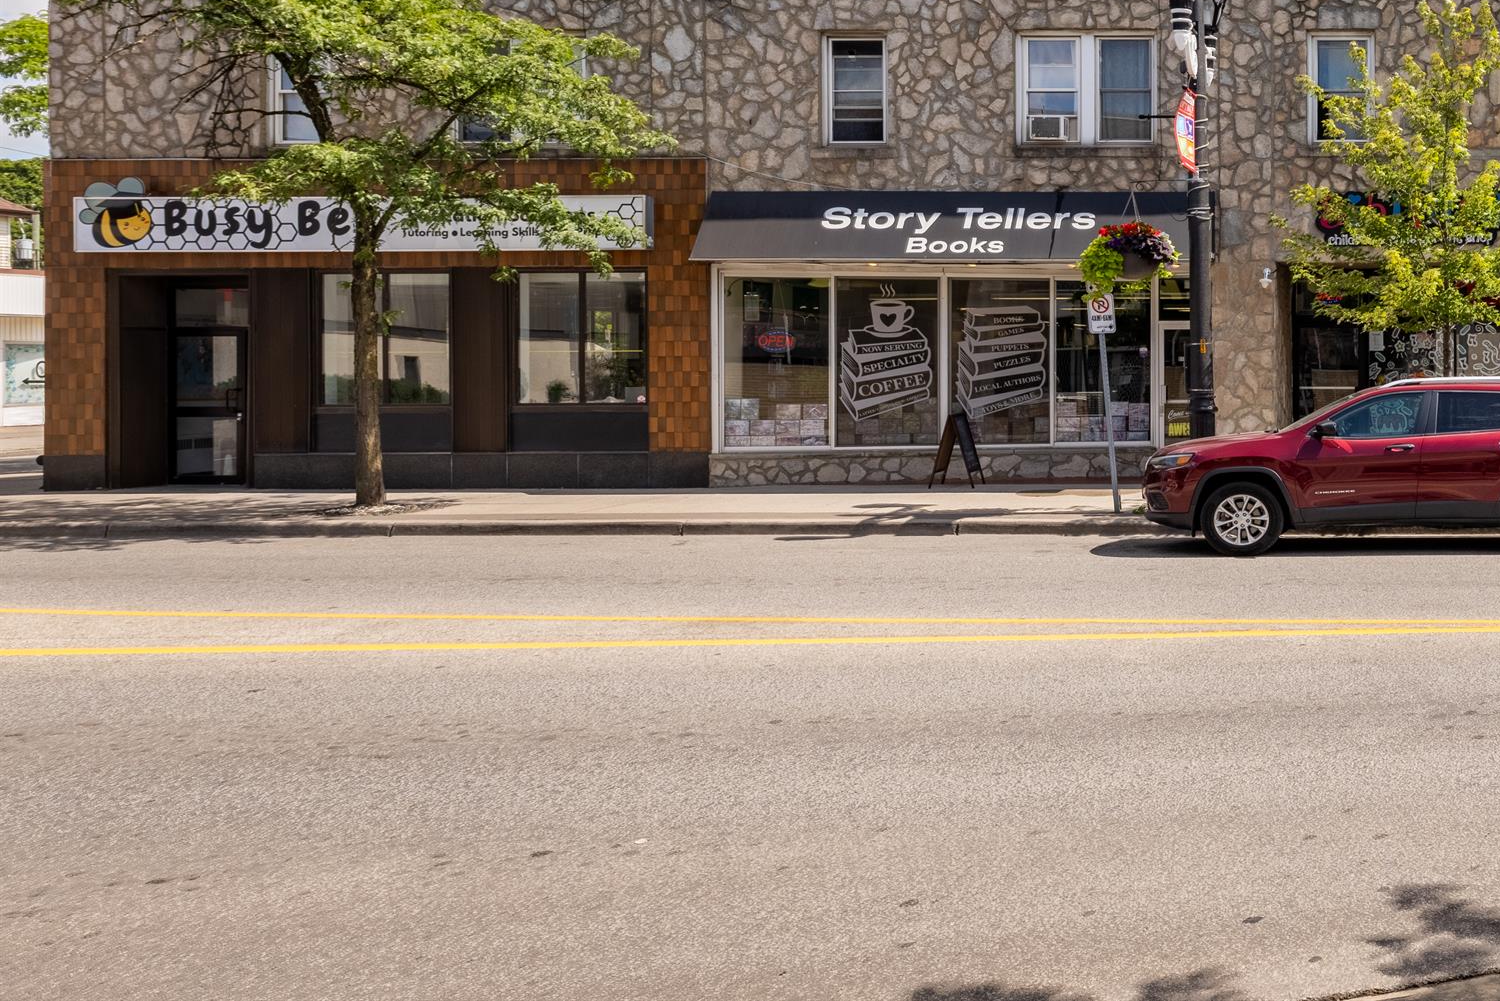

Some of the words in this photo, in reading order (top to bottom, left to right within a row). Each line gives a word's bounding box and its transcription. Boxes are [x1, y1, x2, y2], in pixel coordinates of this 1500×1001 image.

[164, 200, 273, 249] Busy
[821, 206, 942, 234] Story
[956, 207, 1096, 230] Tellers
[905, 237, 1004, 253] Books
[998, 327, 1024, 337] GAMES
[758, 335, 795, 347] OPEN
[884, 342, 922, 350] SERVING
[991, 343, 1030, 352] PUPPETS
[863, 352, 925, 373] SPECIALTY
[993, 356, 1031, 369] PUZZLES
[858, 373, 926, 397] COFFEE
[974, 384, 1002, 393] LOCAL
[1003, 375, 1042, 388] AUTHORS
